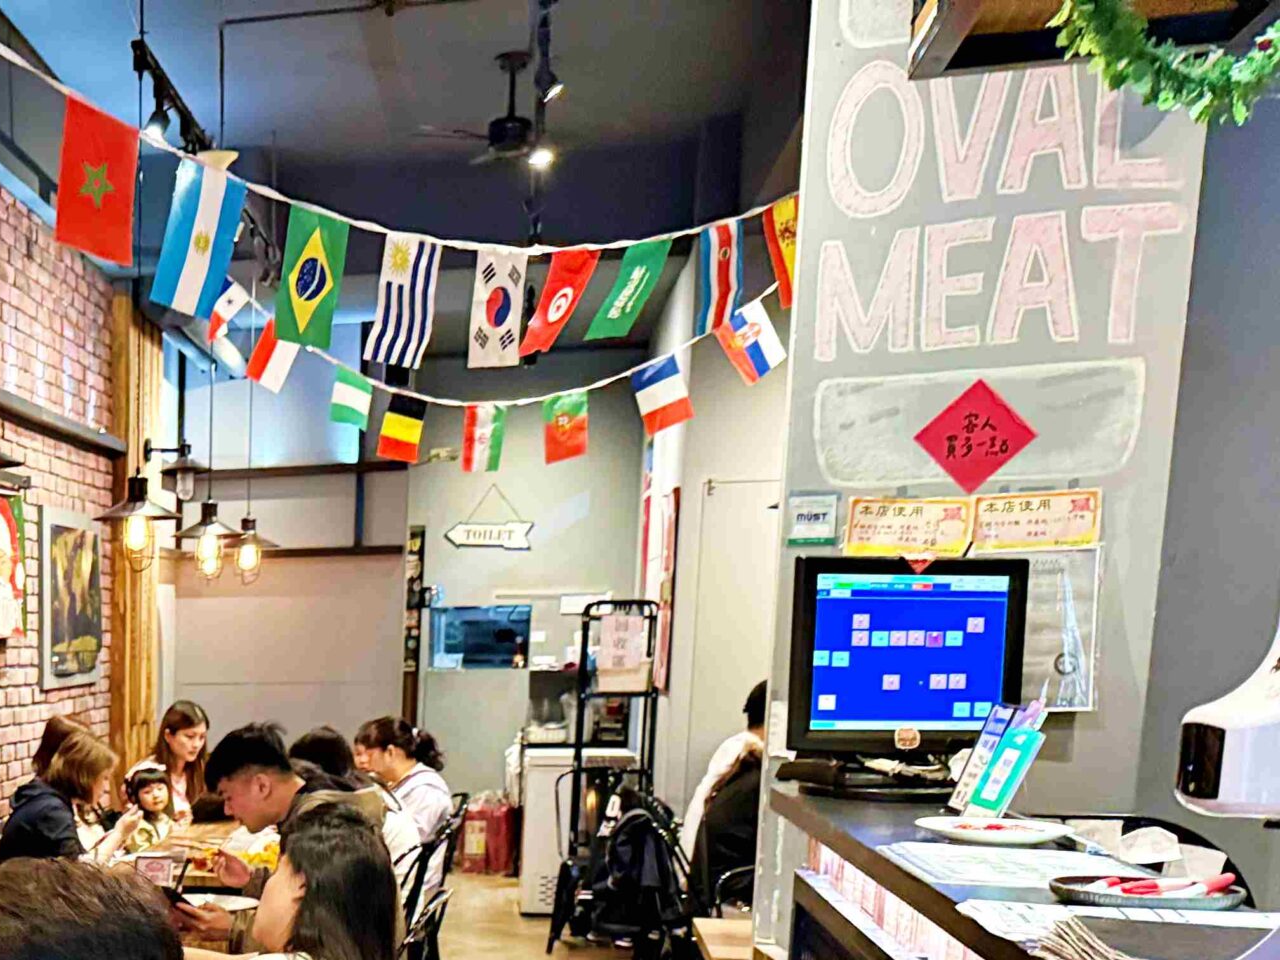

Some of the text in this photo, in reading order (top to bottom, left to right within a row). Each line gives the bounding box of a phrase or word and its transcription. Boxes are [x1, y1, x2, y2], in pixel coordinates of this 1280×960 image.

[827, 59, 1187, 218] OVAL
[814, 201, 1189, 361] MEAT
[962, 411, 997, 434] 客人
[859, 505, 924, 519] 本店使用
[983, 498, 1052, 514] 本店使用
[464, 529, 514, 541] TOILET
